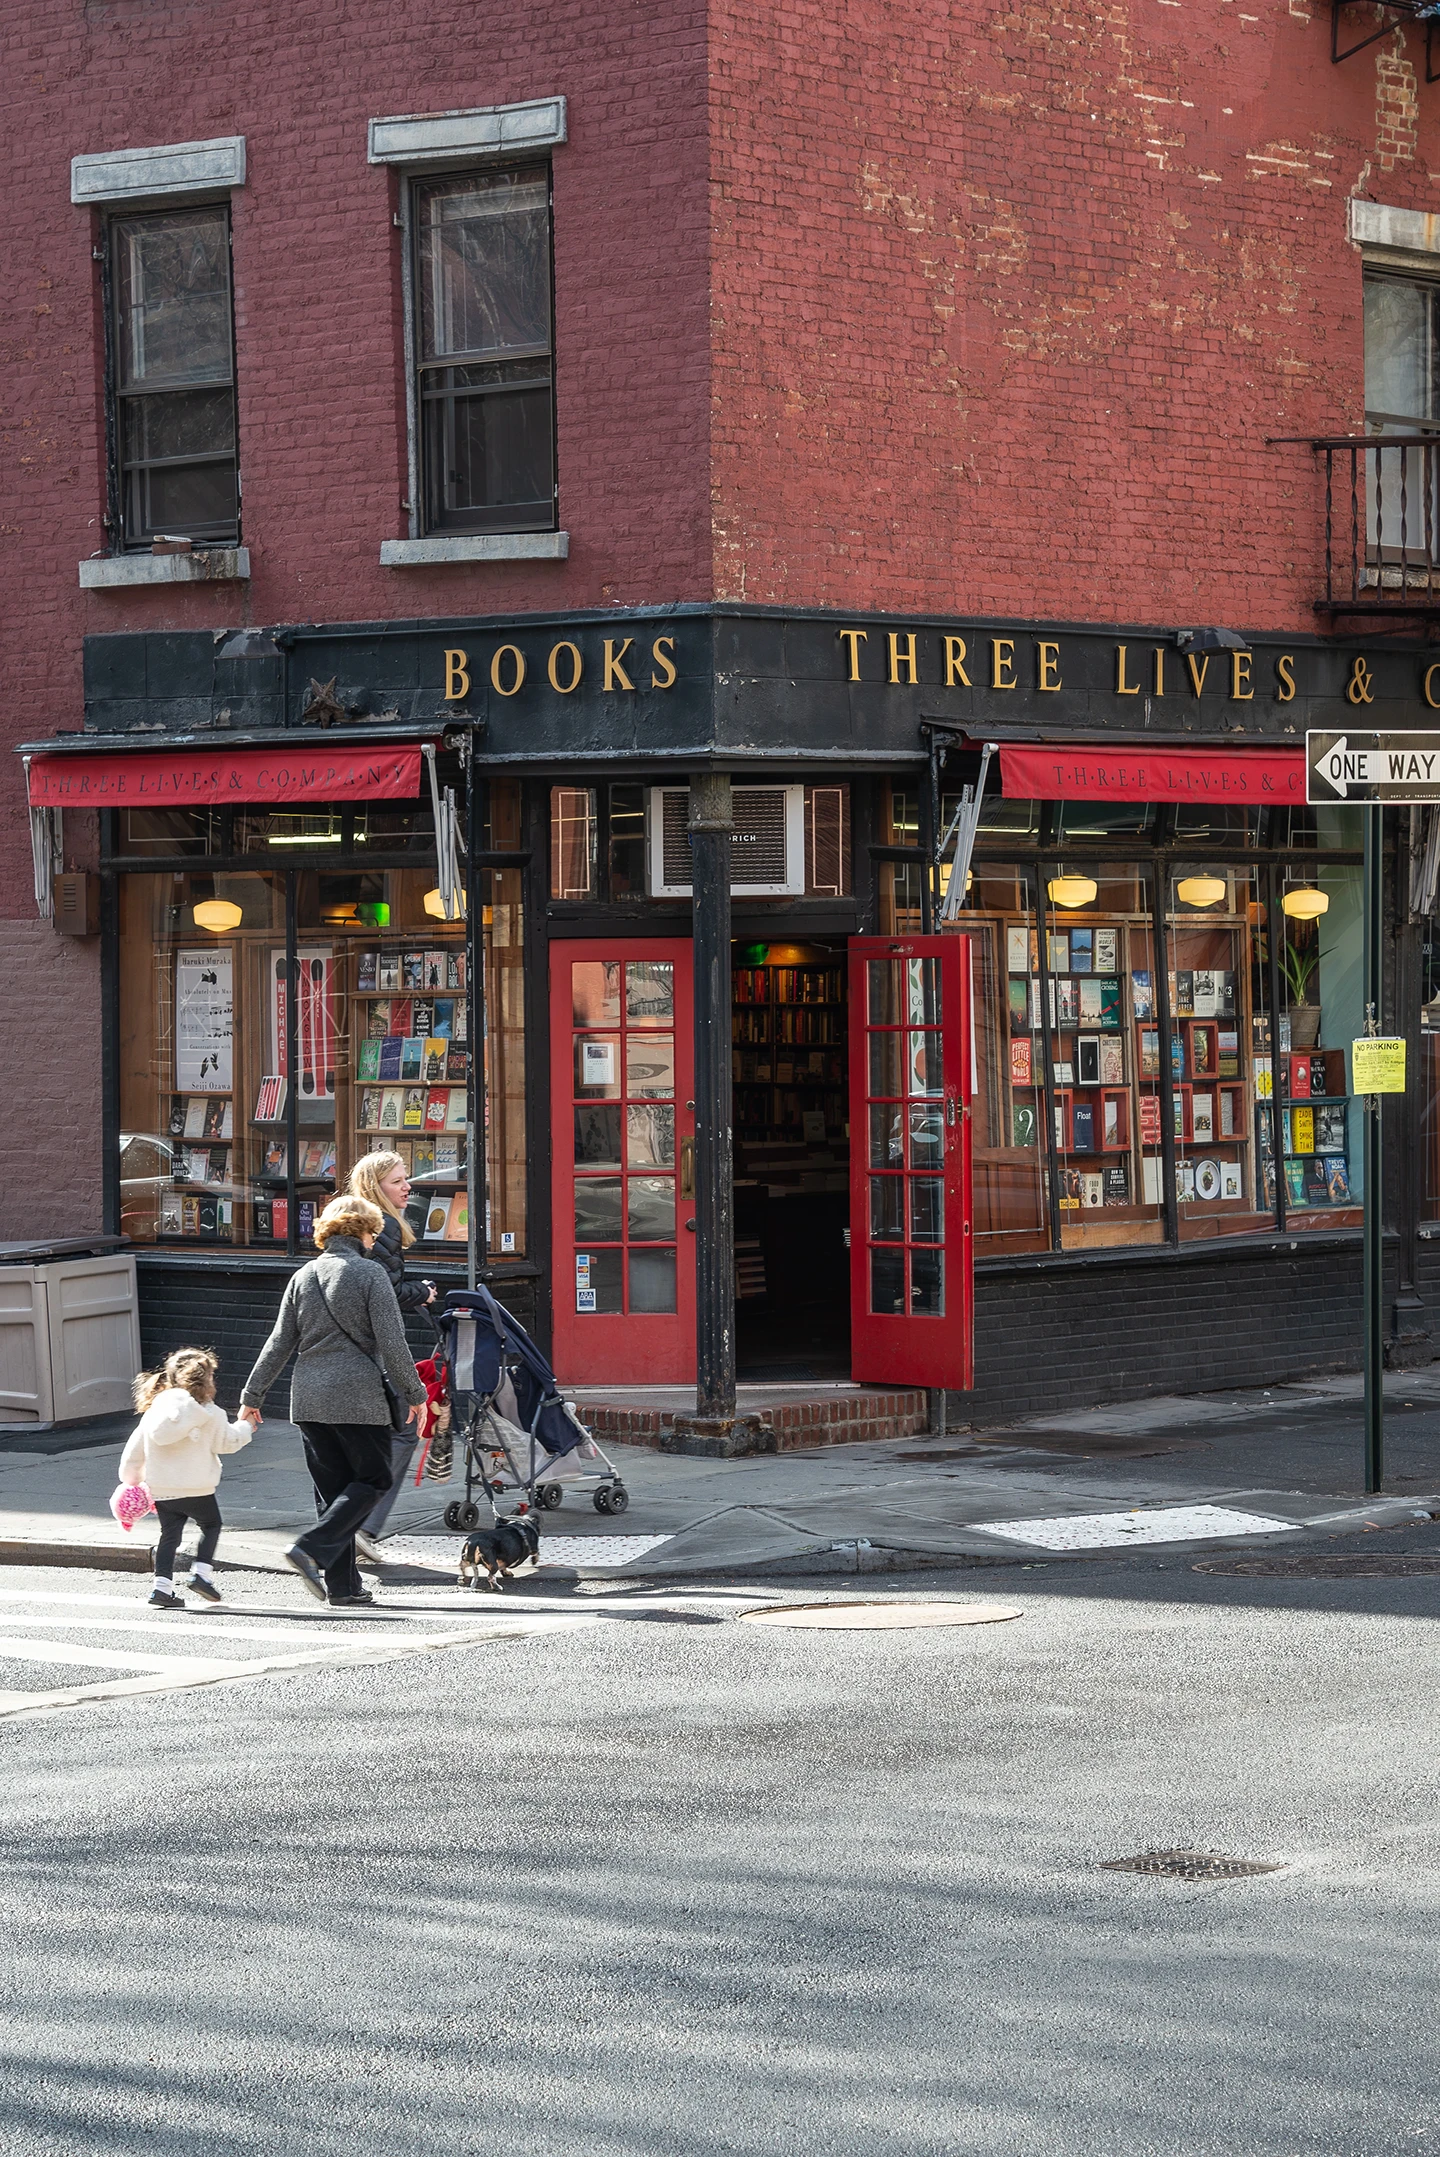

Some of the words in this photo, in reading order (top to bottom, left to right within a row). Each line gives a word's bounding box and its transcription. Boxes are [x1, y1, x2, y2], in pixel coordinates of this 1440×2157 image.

[443, 636, 678, 700] BOOKS
[839, 629, 1063, 691] THREE
[1116, 645, 1297, 701] LIVES
[1348, 656, 1375, 704] &
[1330, 754, 1368, 780] ONE
[1388, 754, 1436, 780] WAY
[229, 770, 243, 789] &
[1261, 773, 1275, 791] &
[182, 957, 205, 965] Haruki
[1366, 1043, 1399, 1051] PARKING
[191, 1082, 207, 1091] Seiji
[209, 1082, 231, 1090] Ozawa
[1077, 1111, 1091, 1120] Float
[1298, 1110, 1313, 1118] ZADIE
[1298, 1120, 1313, 1128] SMITH
[1299, 1141, 1313, 1150] TIME
